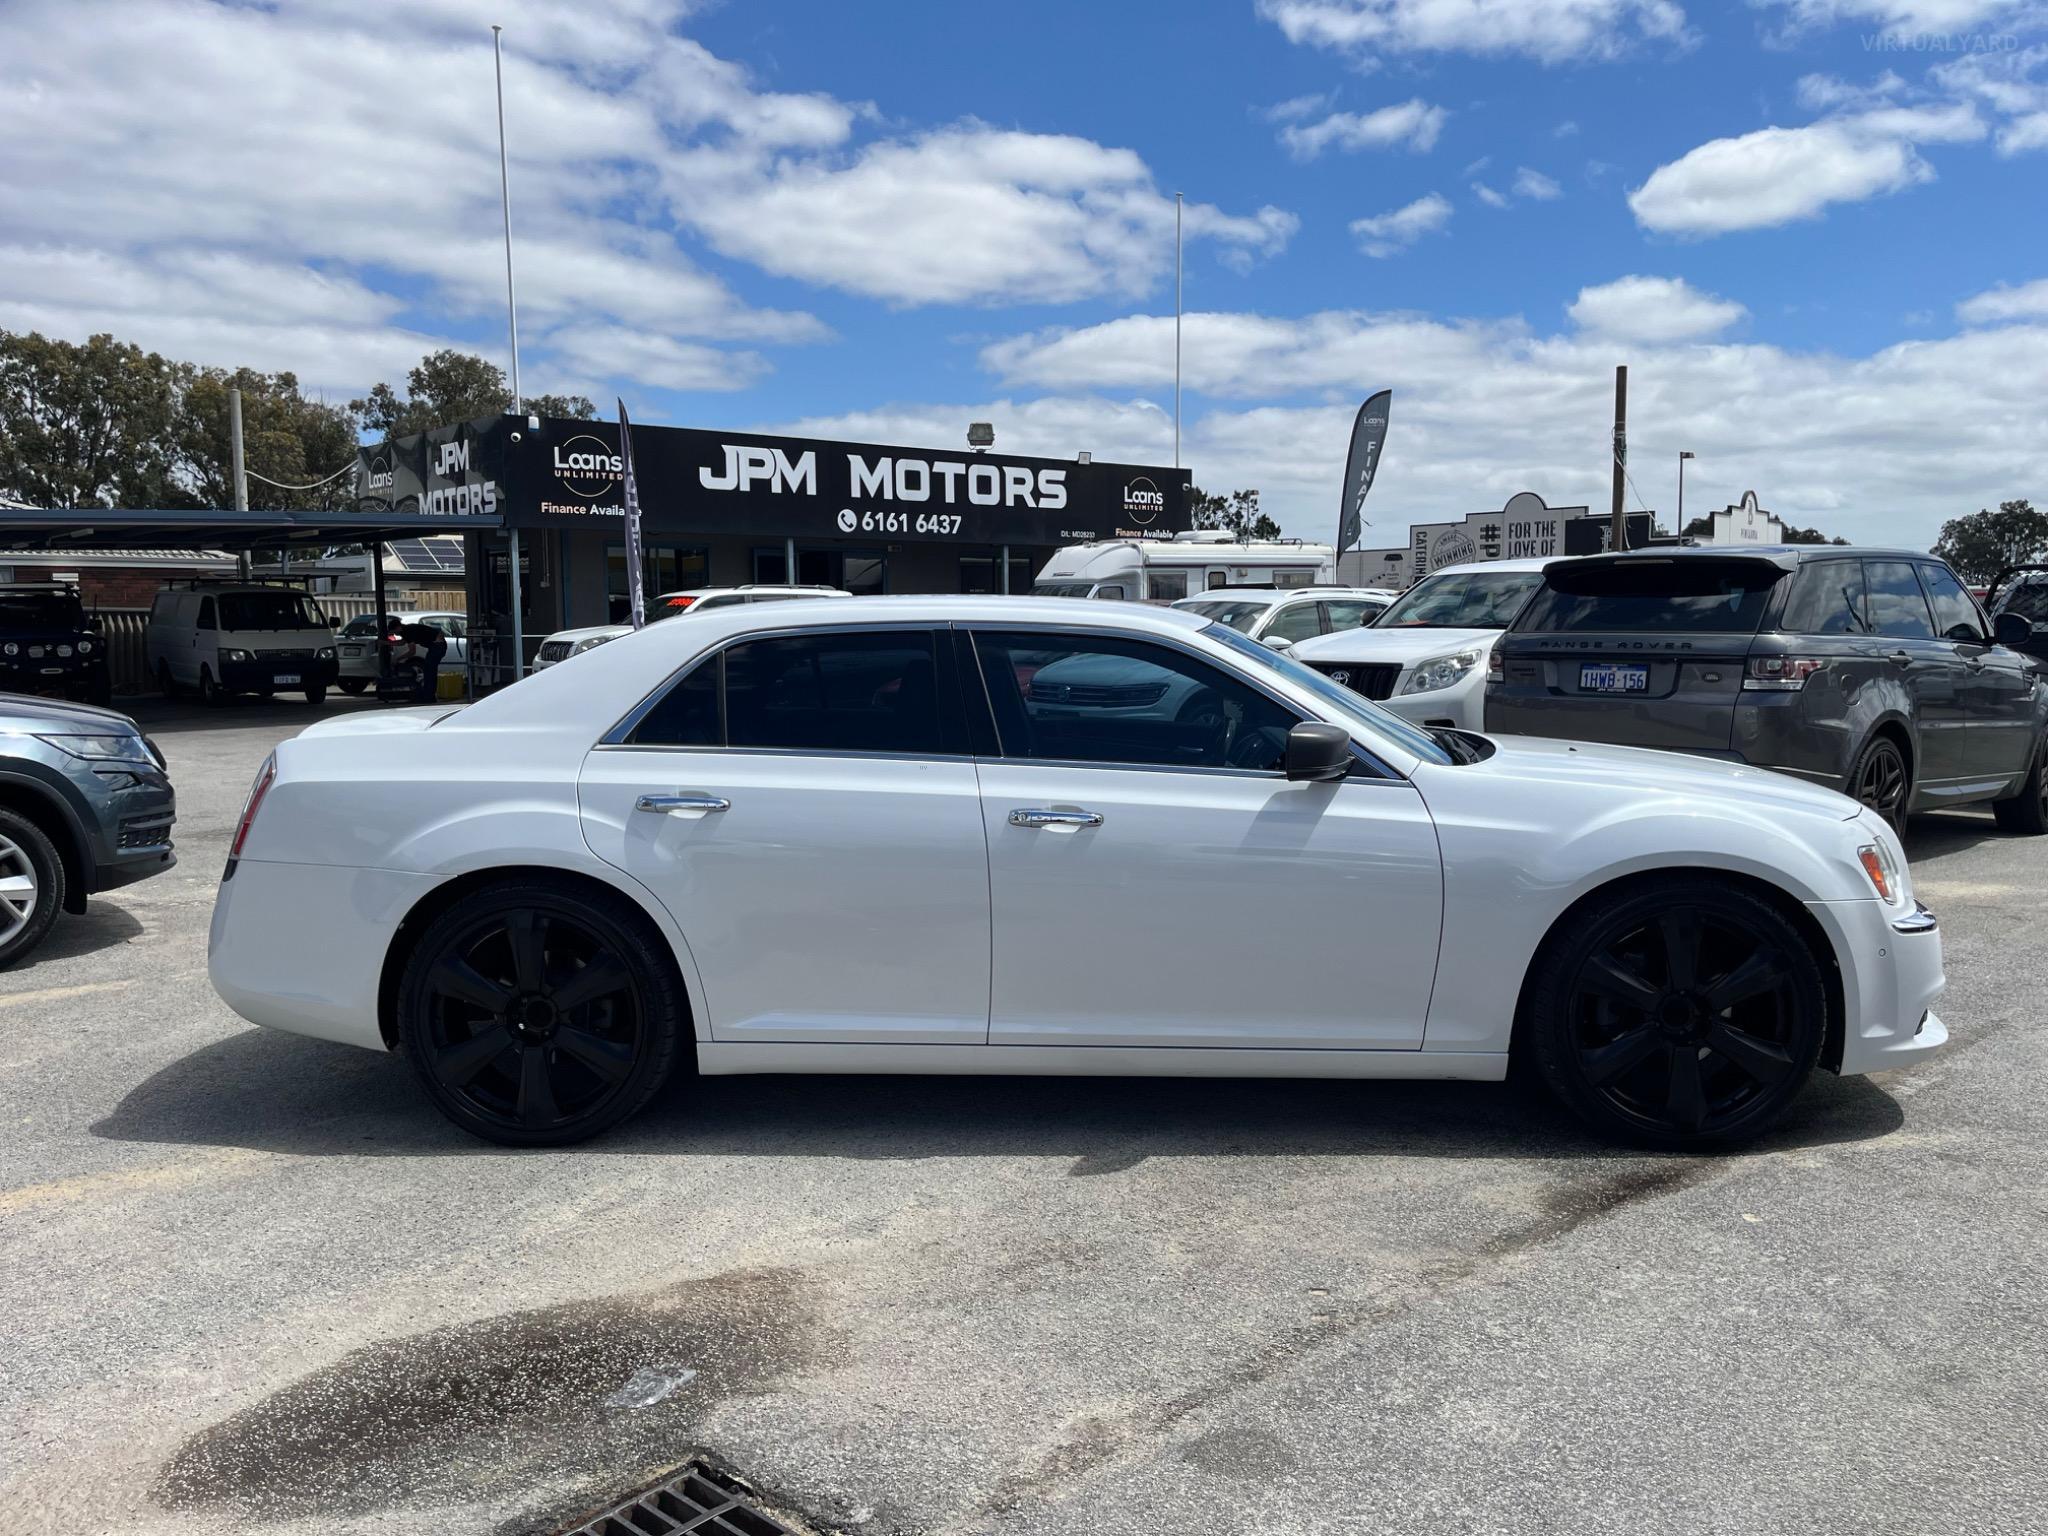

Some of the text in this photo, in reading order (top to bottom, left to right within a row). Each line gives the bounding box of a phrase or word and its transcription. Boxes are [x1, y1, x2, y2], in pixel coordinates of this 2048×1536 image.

[435, 440, 469, 475] JPM
[554, 446, 623, 472] Loans
[368, 471, 392, 489] Loans
[554, 470, 623, 480] UNLIMITED
[699, 444, 1067, 509] JPM MOTORS
[418, 480, 497, 515] MOTORS
[1124, 486, 1164, 504] Loans
[541, 502, 643, 517] Finance Availae
[1124, 504, 1164, 512] UNLIMITED
[861, 511, 962, 534] 6161 6437
[1508, 520, 1557, 539] FOR THE
[1115, 528, 1174, 539] Finance Available
[1433, 543, 1473, 567] WINNING
[1507, 539, 1556, 558] LOVE OF
[1539, 641, 1693, 650] RANGE ROVER
